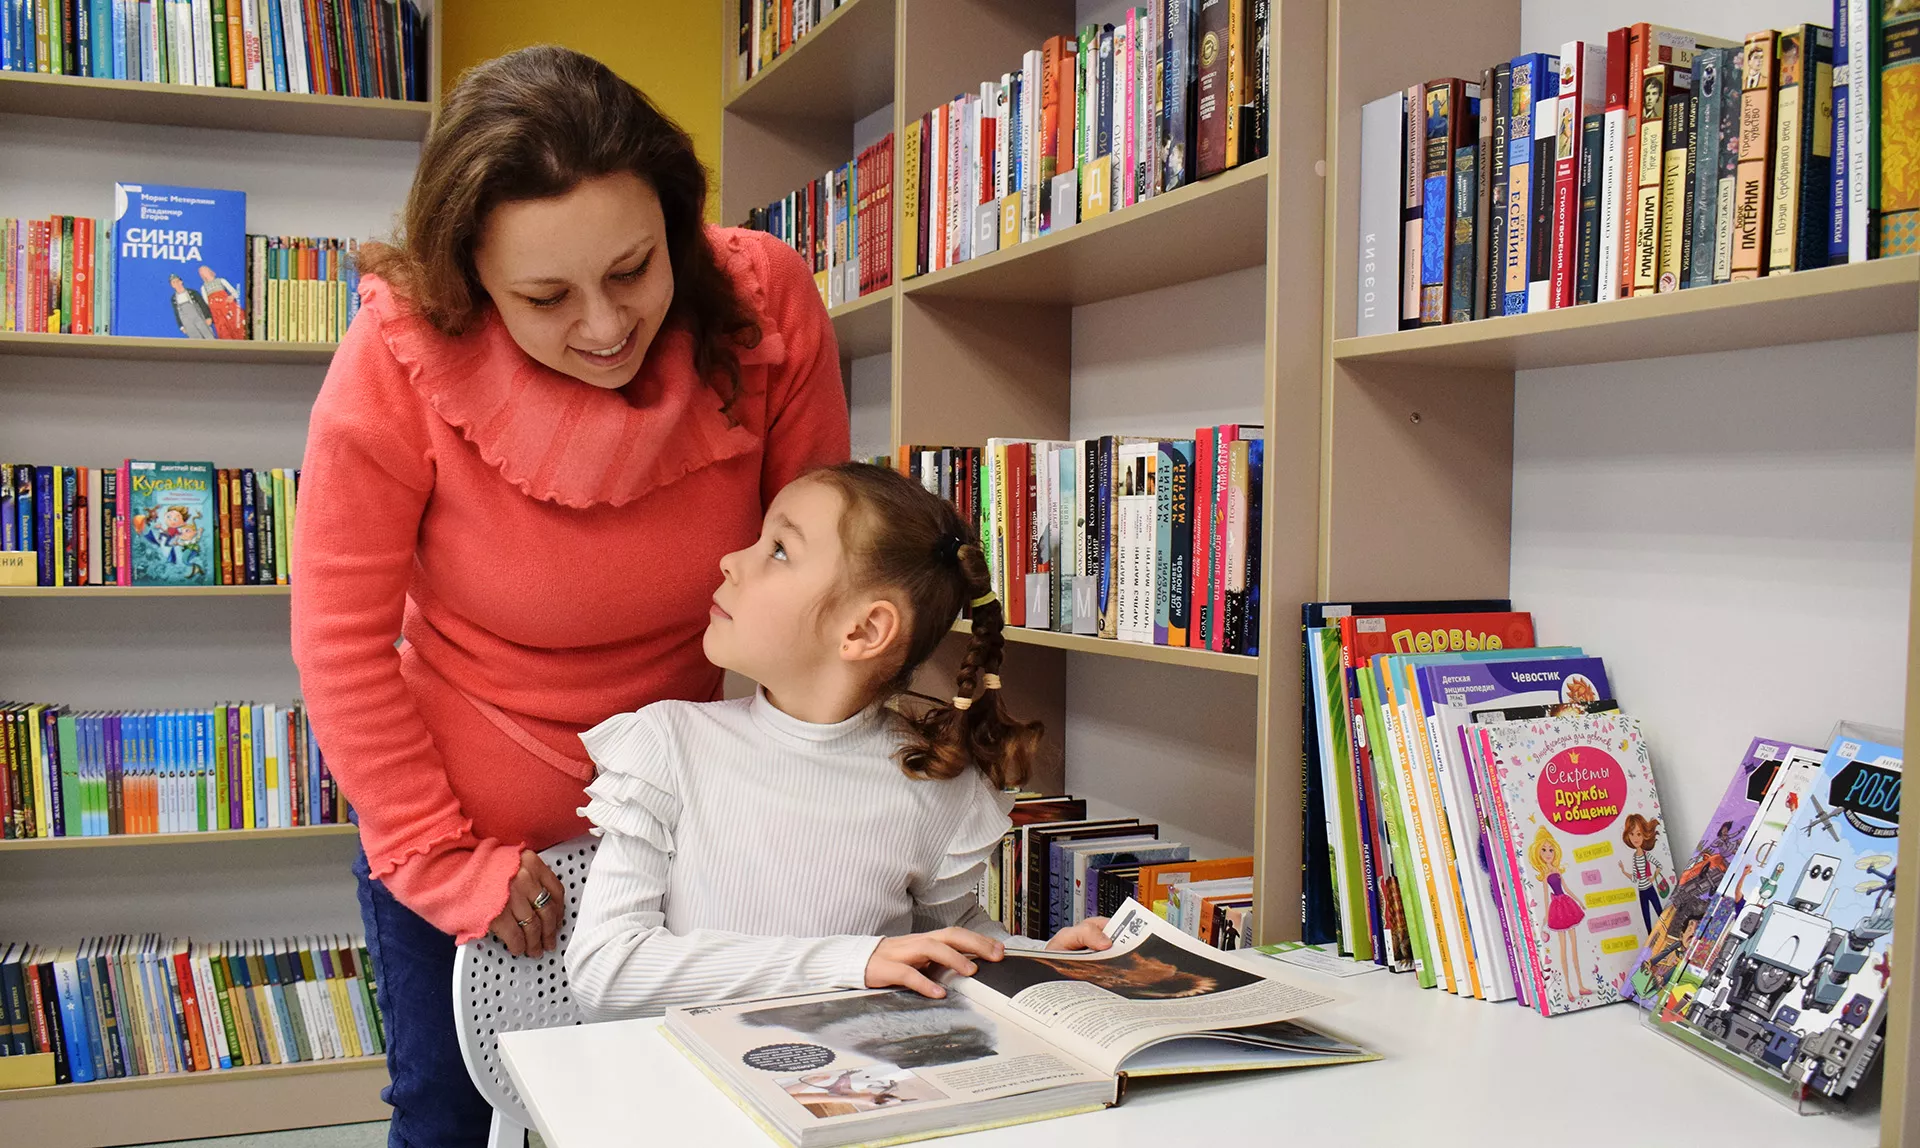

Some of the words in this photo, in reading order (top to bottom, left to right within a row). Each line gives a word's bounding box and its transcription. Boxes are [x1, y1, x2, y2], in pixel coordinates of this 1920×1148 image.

[245, 30, 254, 71] СОКРОВИЩ
[252, 36, 261, 64] ОСТРОВ
[1041, 48, 1054, 110] Стоуна
[1164, 50, 1173, 119] НАДЕЖДЫ
[1171, 50, 1181, 114] БОЛЬШИЕ
[1853, 41, 1864, 145] СЕРЕБРЯНОГО
[1743, 94, 1754, 127] диктует
[1837, 97, 1846, 118] ВЕКА
[1608, 120, 1616, 152] ПОЭМЫ
[1740, 129, 1753, 157] Строку
[1781, 120, 1791, 139] века
[1112, 124, 1123, 173] ДЖИО
[1494, 116, 1505, 176] ЕСЕНИН
[1687, 132, 1697, 174] МАРШАК
[1835, 120, 1846, 175] СЕРЕБРЯНОГО
[1625, 146, 1635, 216] МАЯКОВСКИЙ
[1777, 142, 1792, 200] Серебряного
[1853, 152, 1863, 203] ПОЭТЫ
[141, 193, 168, 203] Морис
[170, 195, 215, 206] Метерлинк
[1058, 183, 1071, 215] Г
[1087, 167, 1102, 209] Д
[1112, 175, 1120, 207] САРА
[1604, 165, 1613, 239] СТИХОТВОРЕНИЯ
[1834, 179, 1845, 206] ПОЭТЫ
[141, 206, 183, 218] Владимир
[141, 213, 169, 222] Егоров
[980, 212, 993, 241] Б
[1004, 207, 1016, 234] В
[1662, 165, 1680, 267] Мандельштам
[1719, 186, 1730, 238] ОКУДЖАВА
[1735, 204, 1744, 229] Борис
[1742, 179, 1759, 250] ПАСТЕРНАК
[1774, 203, 1788, 235] Поэзия
[1833, 208, 1844, 243] РУССКИЕ
[126, 227, 203, 247] СИНЯЯ
[1508, 191, 1520, 267] ЕСЕНИН
[1641, 195, 1656, 277] МАНДЕЛЬШТАМ
[122, 242, 203, 264] ПТИЦА
[1491, 216, 1503, 310] Стихотворения
[1622, 219, 1632, 276] ВЛАДИМИР
[1718, 241, 1728, 270] БУЛАТ
[835, 266, 842, 289] О
[845, 265, 857, 290] П
[1364, 232, 1376, 319] ПОЭЗИЯ
[1555, 272, 1564, 309] ПОЭМЫ
[1219, 443, 1228, 492] КАТАЖИНА
[132, 474, 207, 497] Кусалки
[1178, 463, 1186, 524] МАРТИН
[1228, 487, 1236, 525] После
[1161, 562, 1169, 588] БУРИ
[1175, 554, 1183, 593] ЛЮБОВЬ
[1076, 587, 1091, 618] М
[1161, 589, 1168, 603] ОТ
[1224, 594, 1232, 635] ДЖОДЖО
[1243, 595, 1251, 636] ДЖОДЖО
[1391, 628, 1503, 654] Первые
[1442, 674, 1471, 685] Детская
[1511, 670, 1561, 684] Чевостик
[1443, 684, 1496, 695] энциклопедия
[1384, 709, 1393, 732] Роботы
[1391, 713, 1405, 748] РАБОТЕ
[1414, 708, 1425, 731] ДЕТЕЙ
[1429, 720, 1438, 743] космос
[1398, 750, 1408, 765] НА
[1420, 732, 1434, 770] МАЛЕНЬКИХ
[1402, 767, 1418, 807] ДЕЛАЮТ
[1427, 771, 1438, 785] ДЛЯ
[1545, 761, 1610, 789] Секреты
[1430, 786, 1447, 835] БЕЗОПАСНОСТИ
[1495, 795, 1505, 817] ДРУЖБЫ
[1554, 785, 1609, 808] Дружбы
[1477, 810, 1487, 835] СЕКРЕТЫ
[1500, 817, 1510, 842] СЕКРЕТЫ
[1552, 810, 1562, 823] и
[1565, 804, 1619, 823] общения
[1411, 810, 1428, 859] ВЗРОСЛЫЕ
[1363, 843, 1374, 892] ДИНОЗАВРЫ
[1442, 836, 1454, 867] ПРАВИЛА
[1422, 862, 1433, 882] ЧТО
